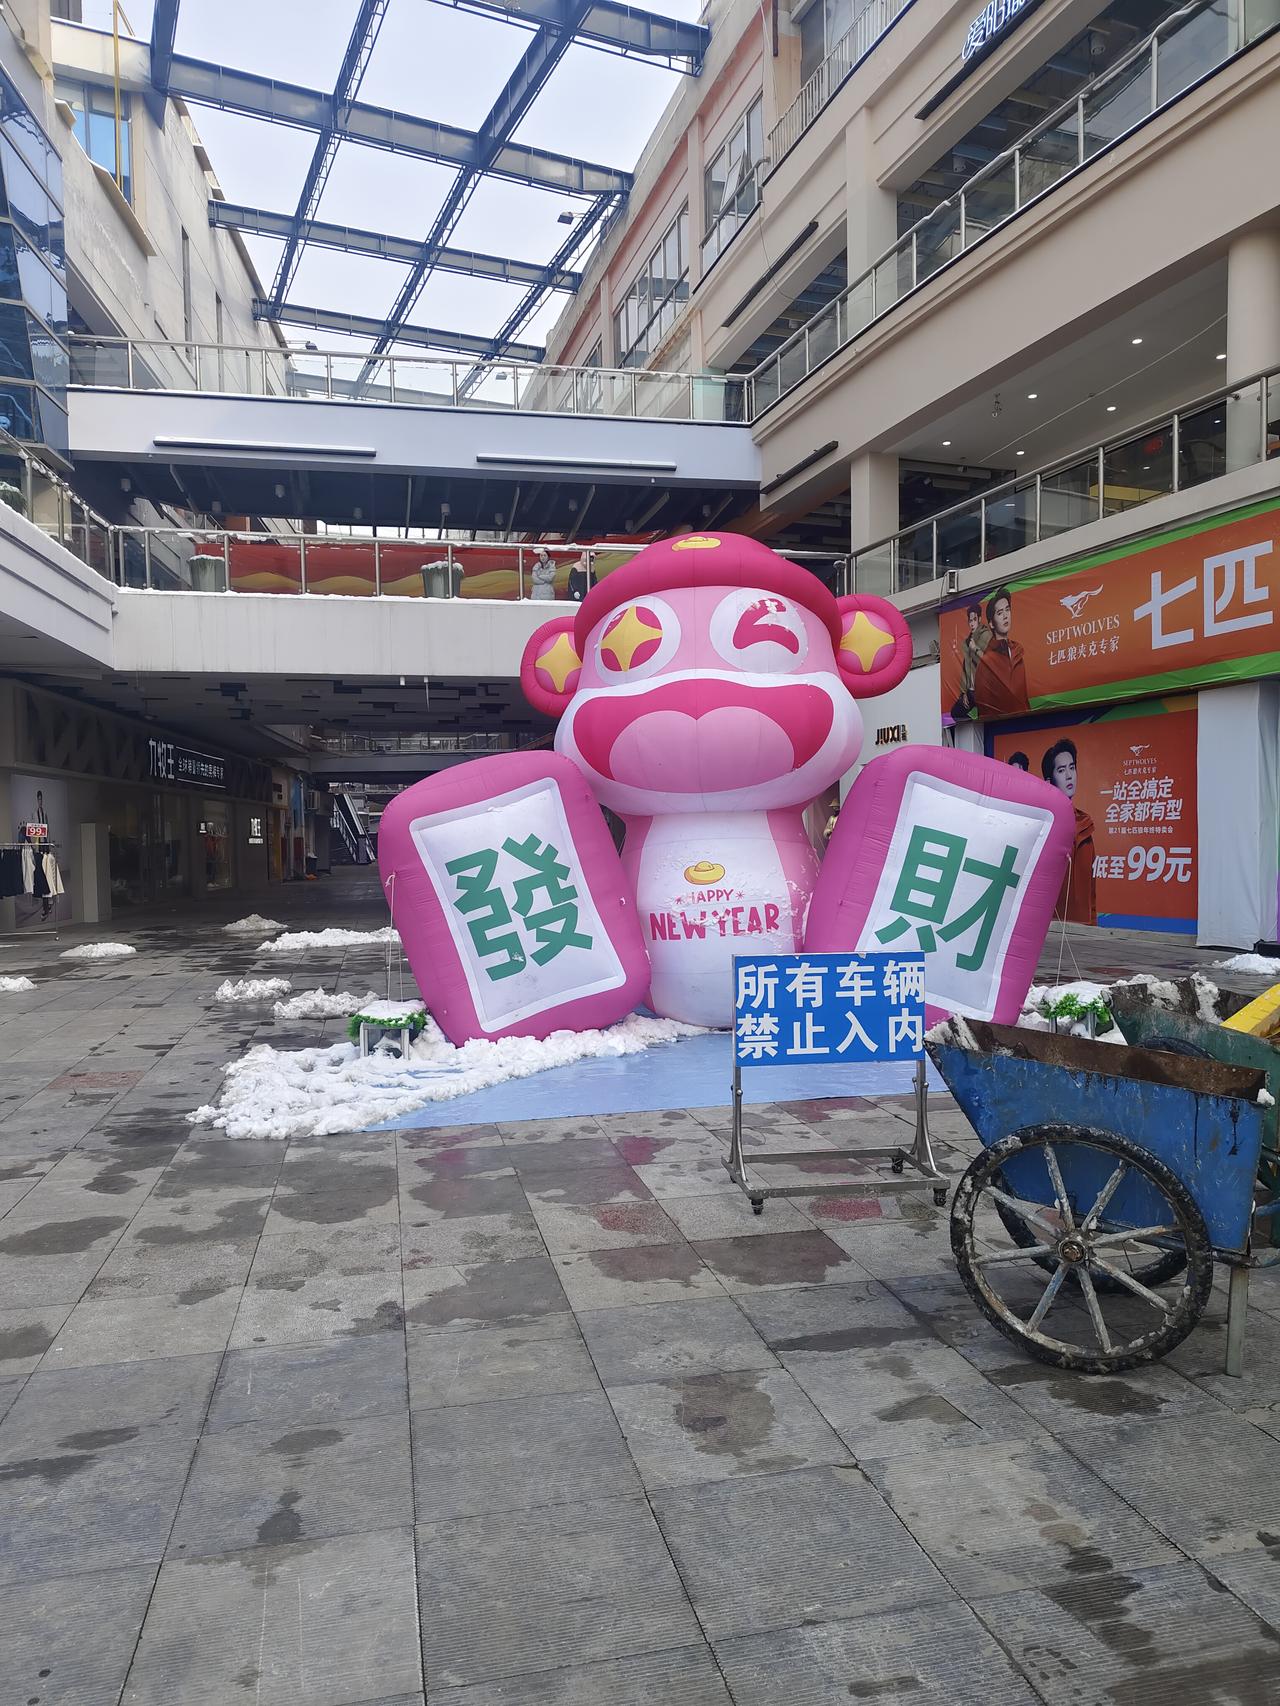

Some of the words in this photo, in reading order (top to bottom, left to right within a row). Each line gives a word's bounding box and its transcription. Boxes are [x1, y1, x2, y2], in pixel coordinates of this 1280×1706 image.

[1133, 539, 1273, 651] 七匹
[1046, 614, 1120, 645] SEPTWOLVES
[1048, 635, 1120, 666] 七匹狼夹克专家
[1100, 776, 1174, 801] 一站全搞定
[1105, 799, 1183, 823] 全家都有型
[1092, 845, 1192, 883] 低至99元
[445, 833, 593, 982] 發
[874, 825, 1021, 972] 財
[649, 911, 707, 940] NEW
[711, 903, 780, 937] YEAR
[736, 960, 925, 1009] 所有车辆
[736, 1008, 925, 1059] 禁止入内
